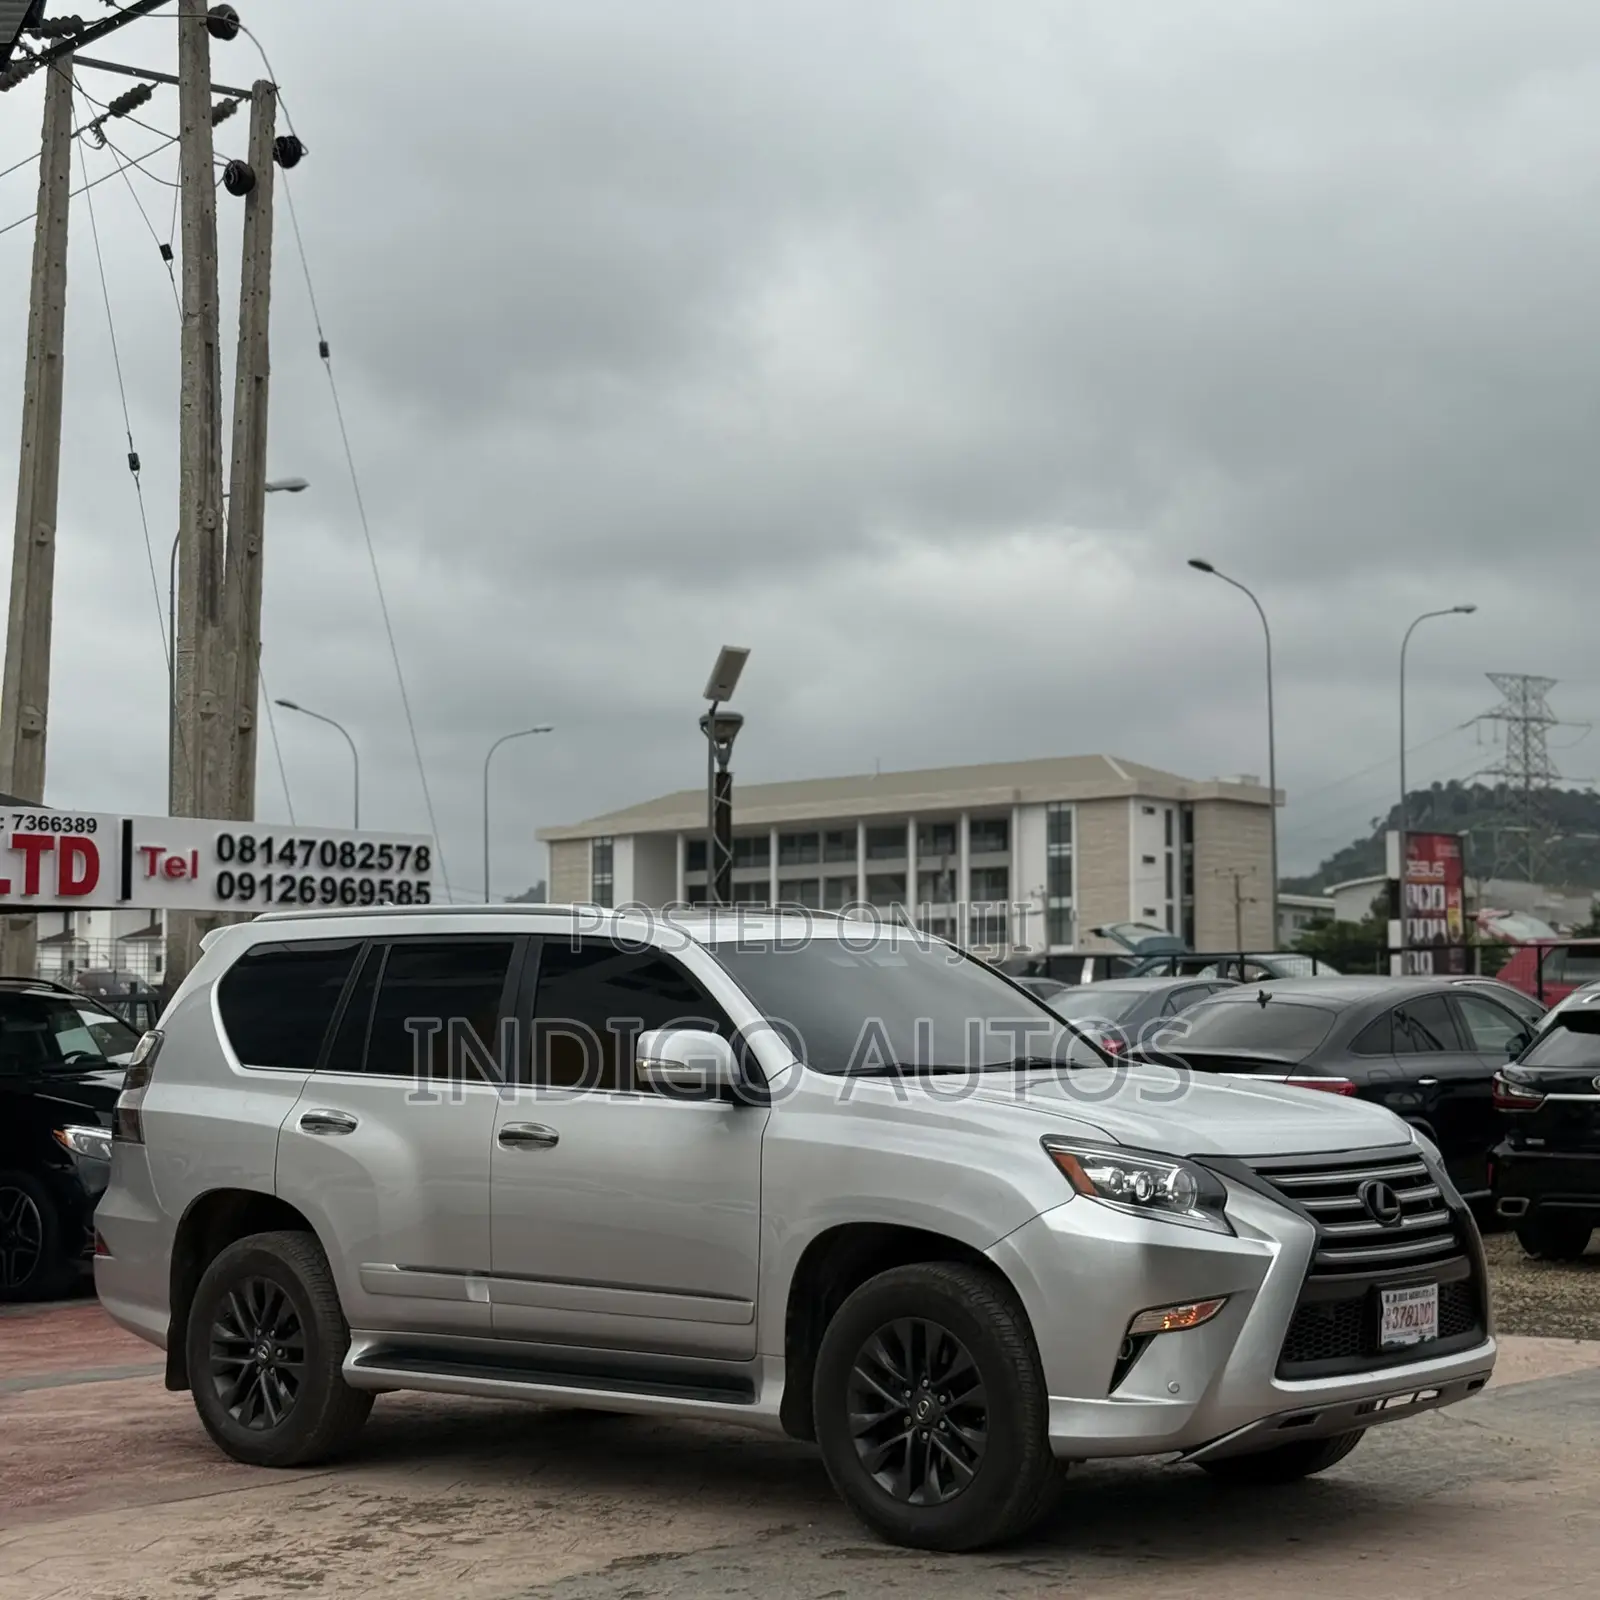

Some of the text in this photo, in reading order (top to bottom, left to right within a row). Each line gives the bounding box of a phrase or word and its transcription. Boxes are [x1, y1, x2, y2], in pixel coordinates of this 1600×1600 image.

[12, 814, 97, 833] 7366389
[0, 833, 100, 896] TD
[139, 846, 198, 879] Tel
[216, 833, 430, 872] 08147082578
[216, 870, 430, 905] 09126969585
